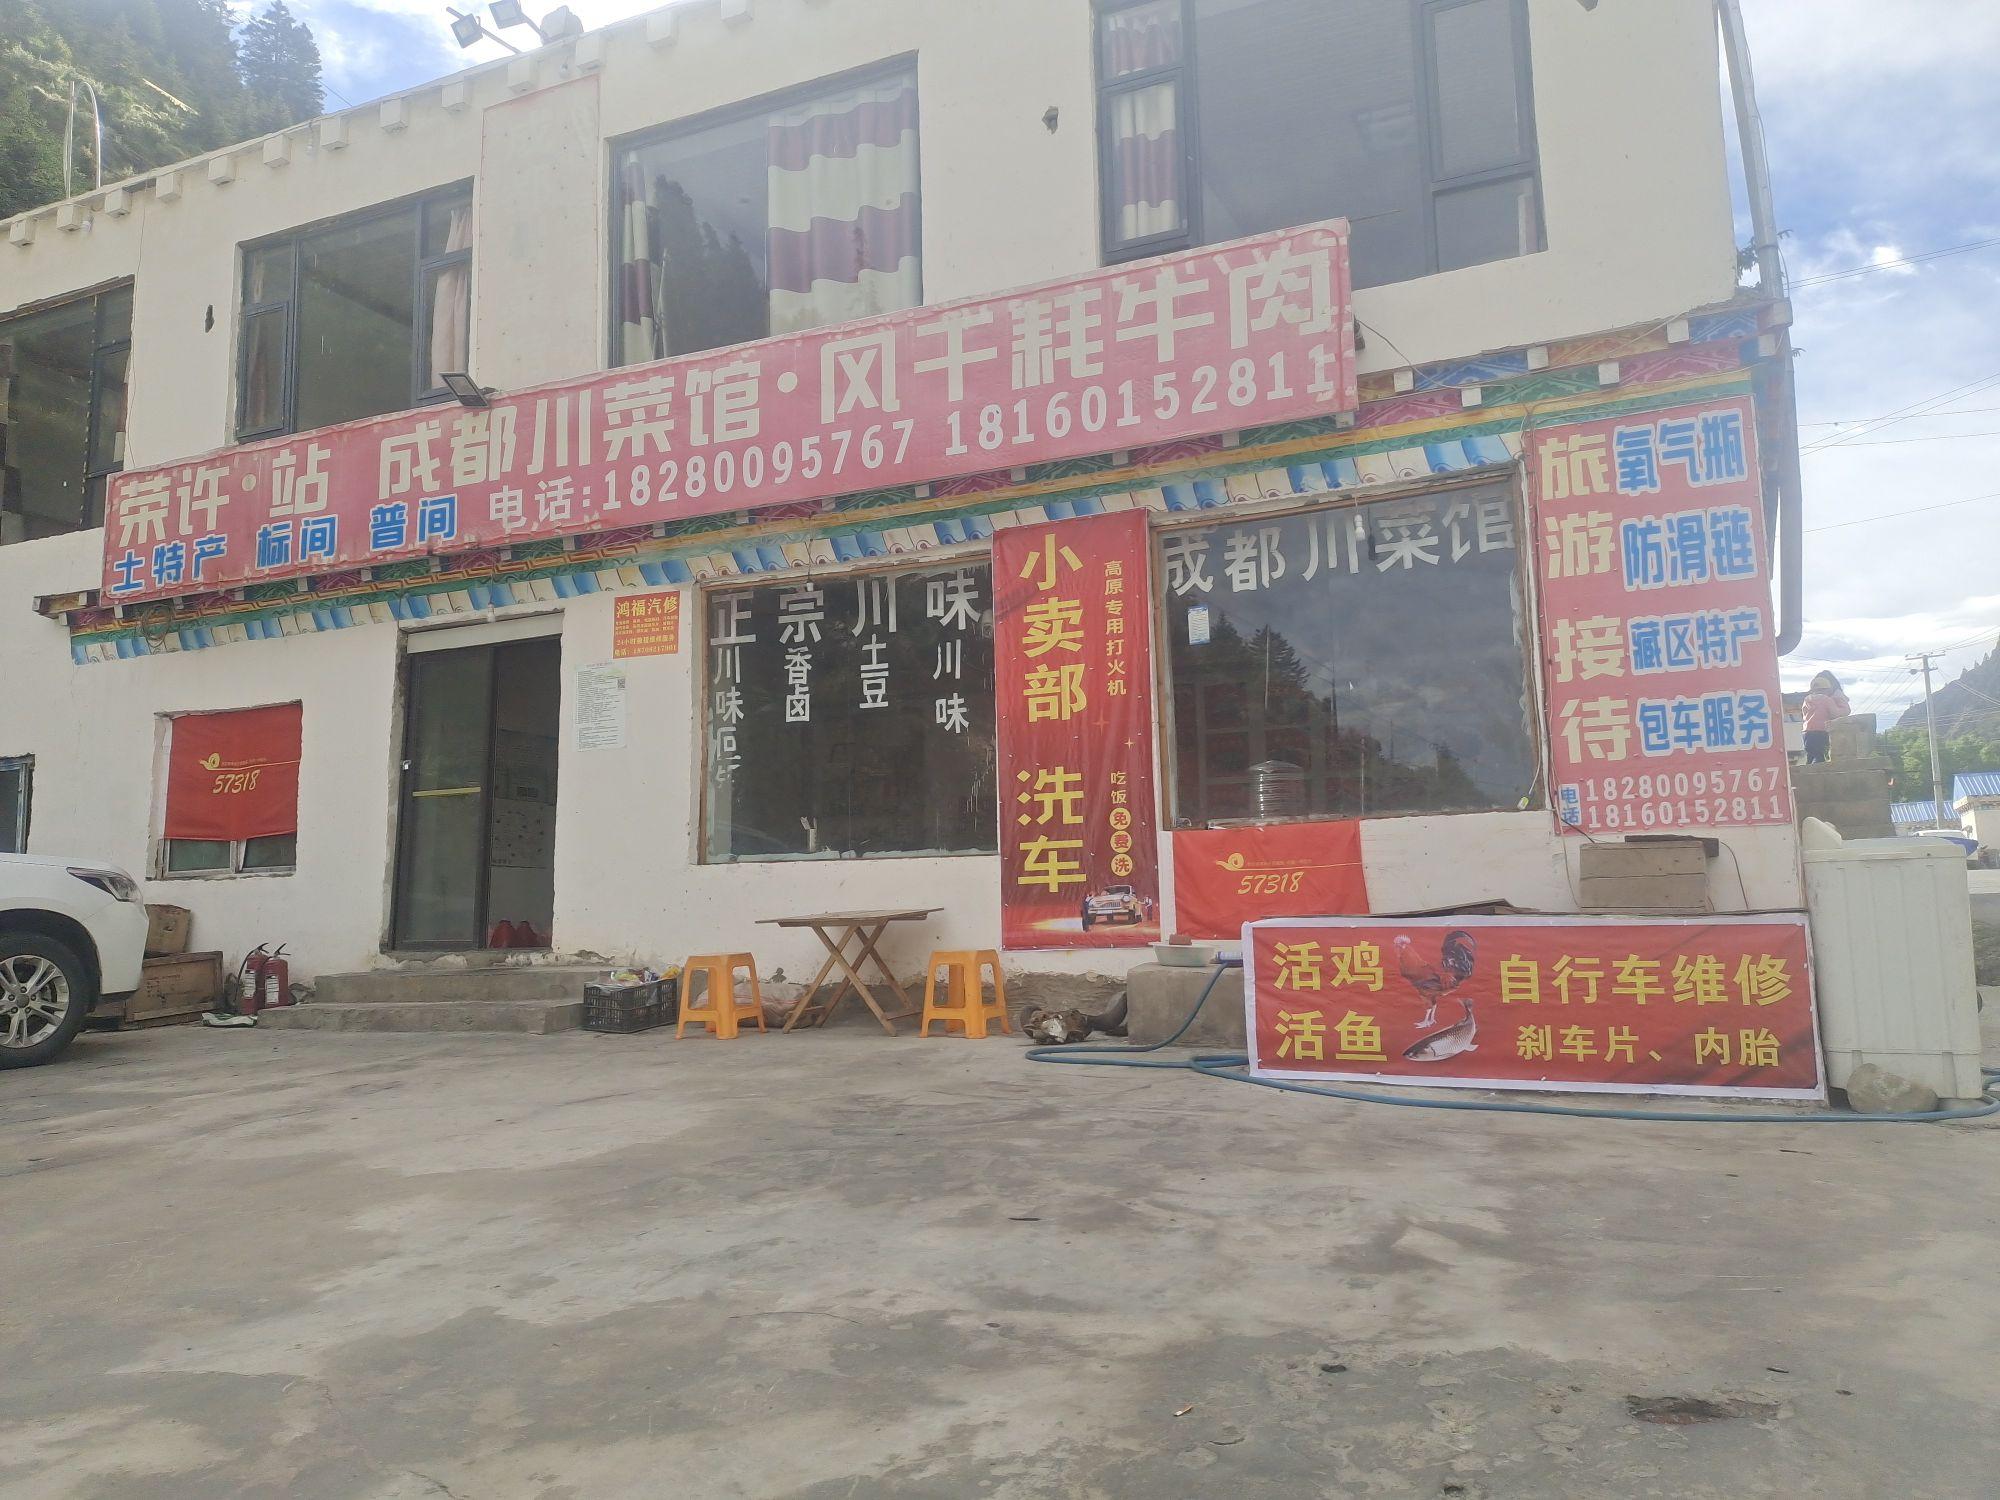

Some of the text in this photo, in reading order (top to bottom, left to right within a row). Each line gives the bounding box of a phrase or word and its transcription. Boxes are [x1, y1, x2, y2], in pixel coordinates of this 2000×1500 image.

[946, 344, 1336, 457] 18160152811
[1614, 410, 1748, 494] 氧气瓶
[256, 515, 338, 569] 标间
[369, 495, 457, 552] 普间
[1163, 500, 1515, 597] 成都川菜馆
[1621, 505, 1757, 591] 防滑链
[616, 596, 678, 618] 鸿福汽修
[710, 571, 982, 646] 正宗川味
[1104, 559, 1127, 697] 高原专用打火机
[1538, 433, 1631, 764] 旅游接待
[859, 633, 889, 709] 土豆
[1628, 608, 1762, 675] 藏区特产
[783, 646, 813, 723] 香卤
[932, 639, 970, 734] 川味
[1017, 533, 1088, 893] 小卖部 洗车
[1637, 691, 1773, 757] 包车服务
[212, 769, 261, 794] 57318
[1560, 786, 1580, 826] 电话
[1586, 767, 1780, 801] 18280095767
[1588, 795, 1783, 828] 18160152811
[1237, 871, 1304, 895] 57318
[1272, 941, 1384, 992] 活鸡
[1500, 954, 1793, 1007] 自行车维修
[1275, 1010, 1388, 1062] 活鱼
